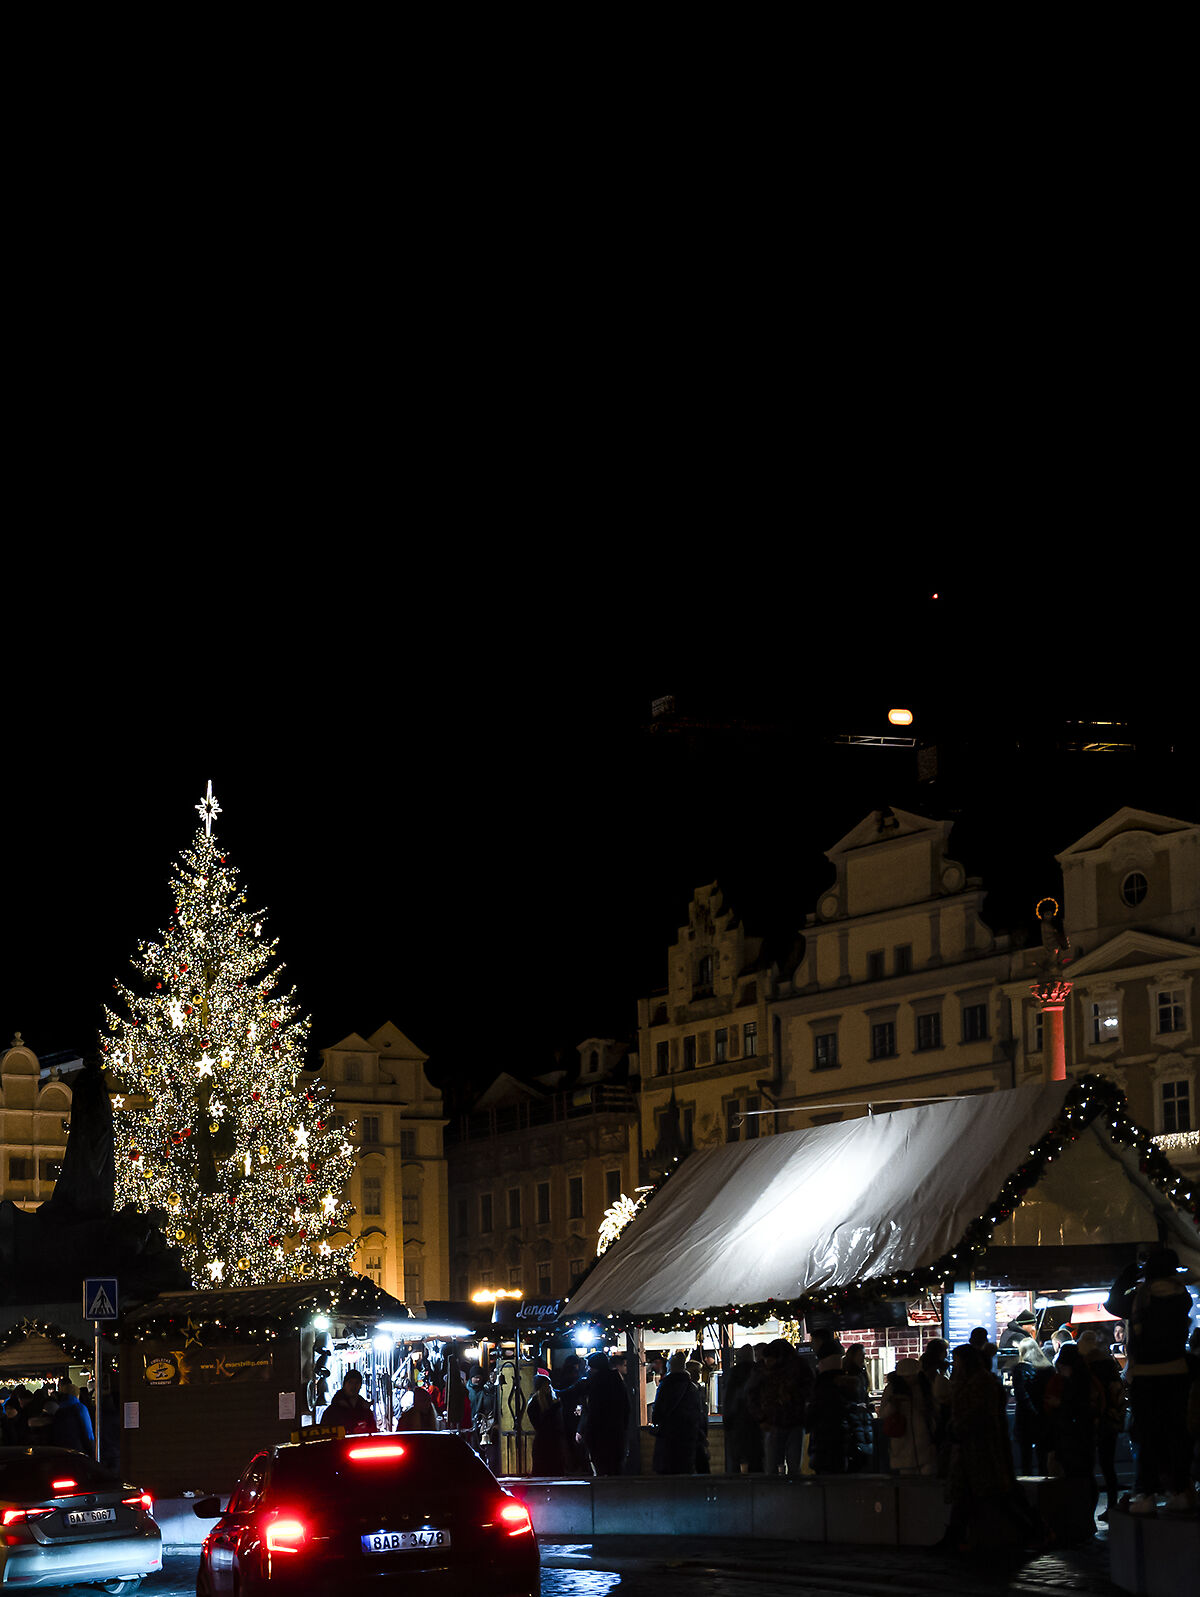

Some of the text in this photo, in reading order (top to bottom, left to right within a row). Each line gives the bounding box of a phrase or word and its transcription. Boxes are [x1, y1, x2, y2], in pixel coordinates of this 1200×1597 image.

[70, 1510, 111, 1523] 8AX 6067
[373, 1531, 444, 1550] 8AB 3478
